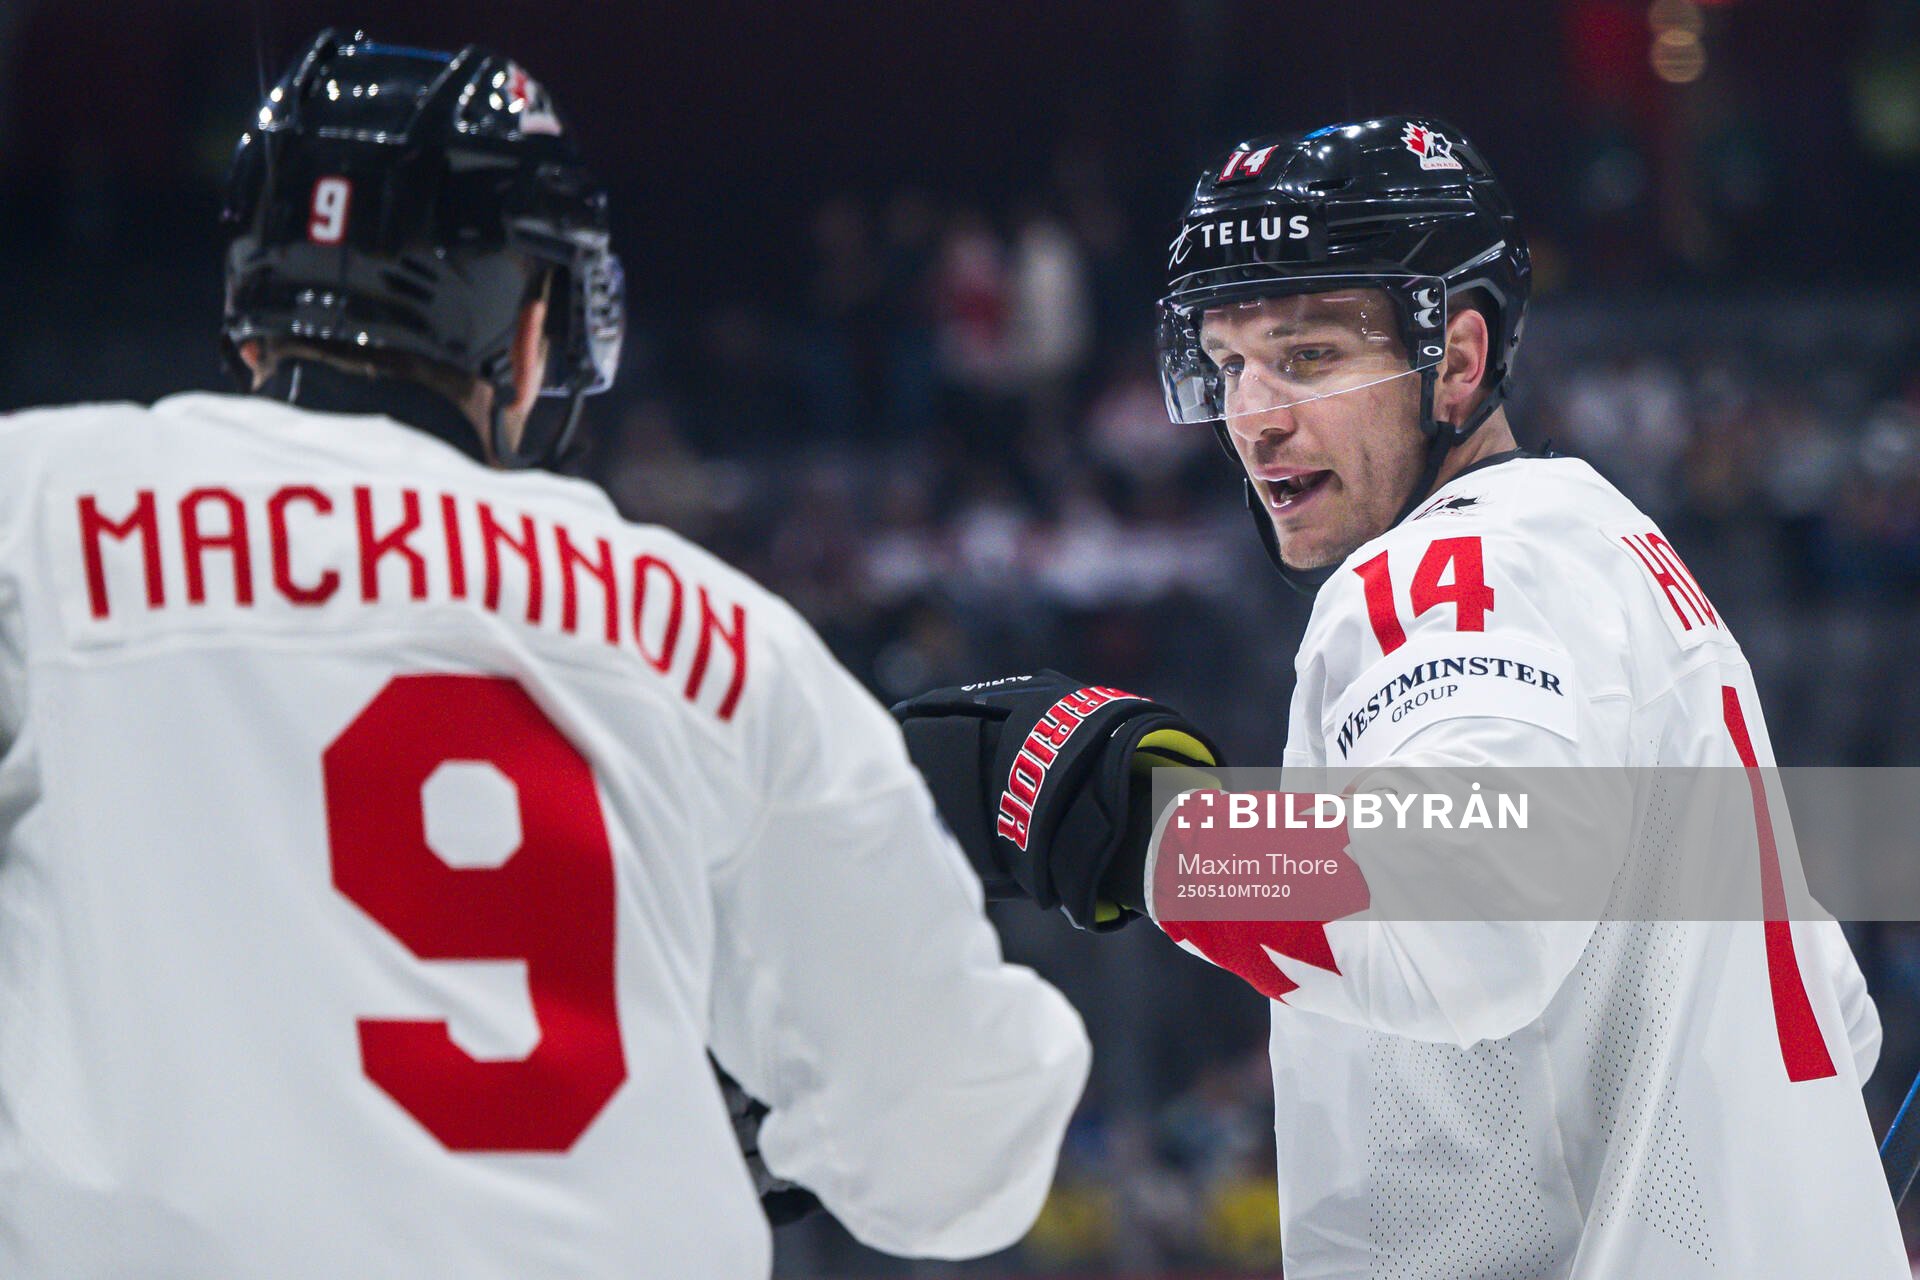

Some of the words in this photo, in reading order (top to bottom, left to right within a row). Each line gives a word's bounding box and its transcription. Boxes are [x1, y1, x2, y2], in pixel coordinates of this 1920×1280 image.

[309, 176, 351, 244] 9
[1219, 145, 1279, 182] 14
[1201, 215, 1310, 249] TELUS
[77, 485, 748, 723] MACKINNON
[1352, 536, 1495, 656] 14
[1620, 532, 1727, 632] HO
[1336, 656, 1564, 761] WESTMINSTER
[1391, 684, 1459, 724] GROUP
[997, 686, 1152, 852] RRIOR
[321, 672, 629, 1154] 9
